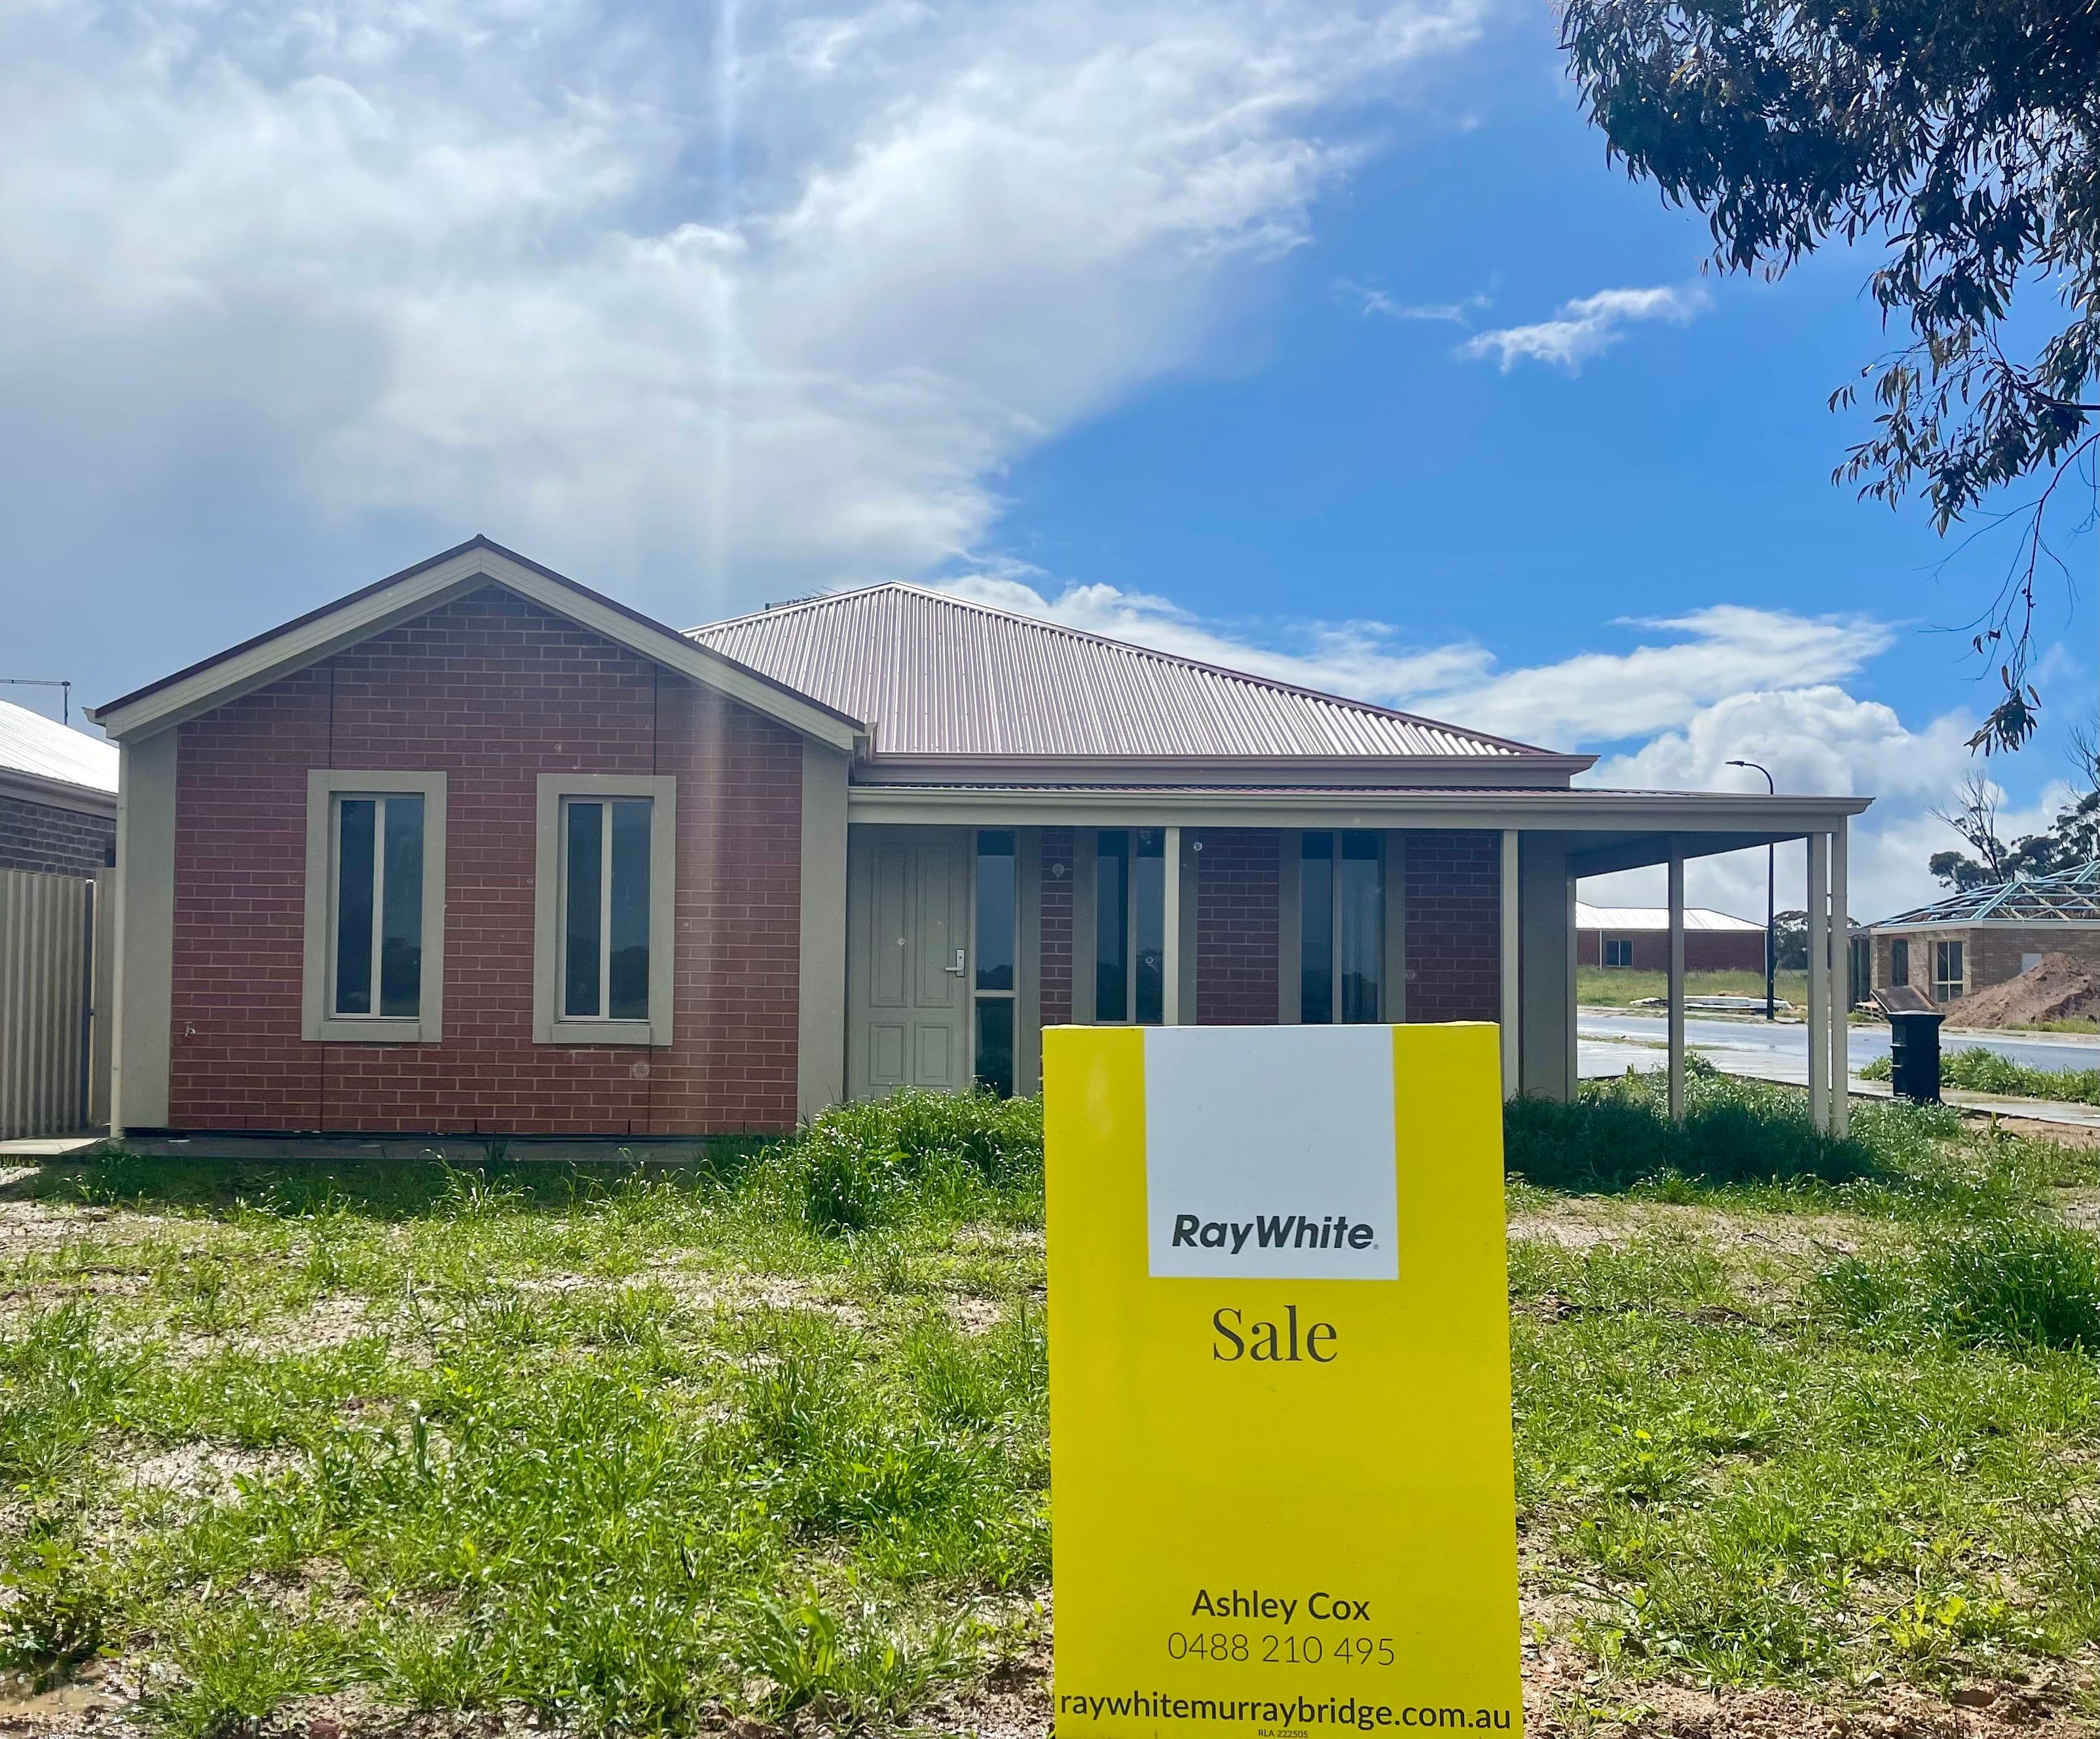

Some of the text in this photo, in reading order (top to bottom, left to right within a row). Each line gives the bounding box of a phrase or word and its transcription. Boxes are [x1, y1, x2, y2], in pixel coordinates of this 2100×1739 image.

[1213, 1305, 1337, 1363] Sale
[1191, 1589, 1371, 1625] Ashley Cox
[1168, 1632, 1395, 1666] 0488 210 495
[1060, 1691, 1511, 1730] raywhitemurraybridge.com.au
[1258, 1729, 1308, 1738] RLA 222505
